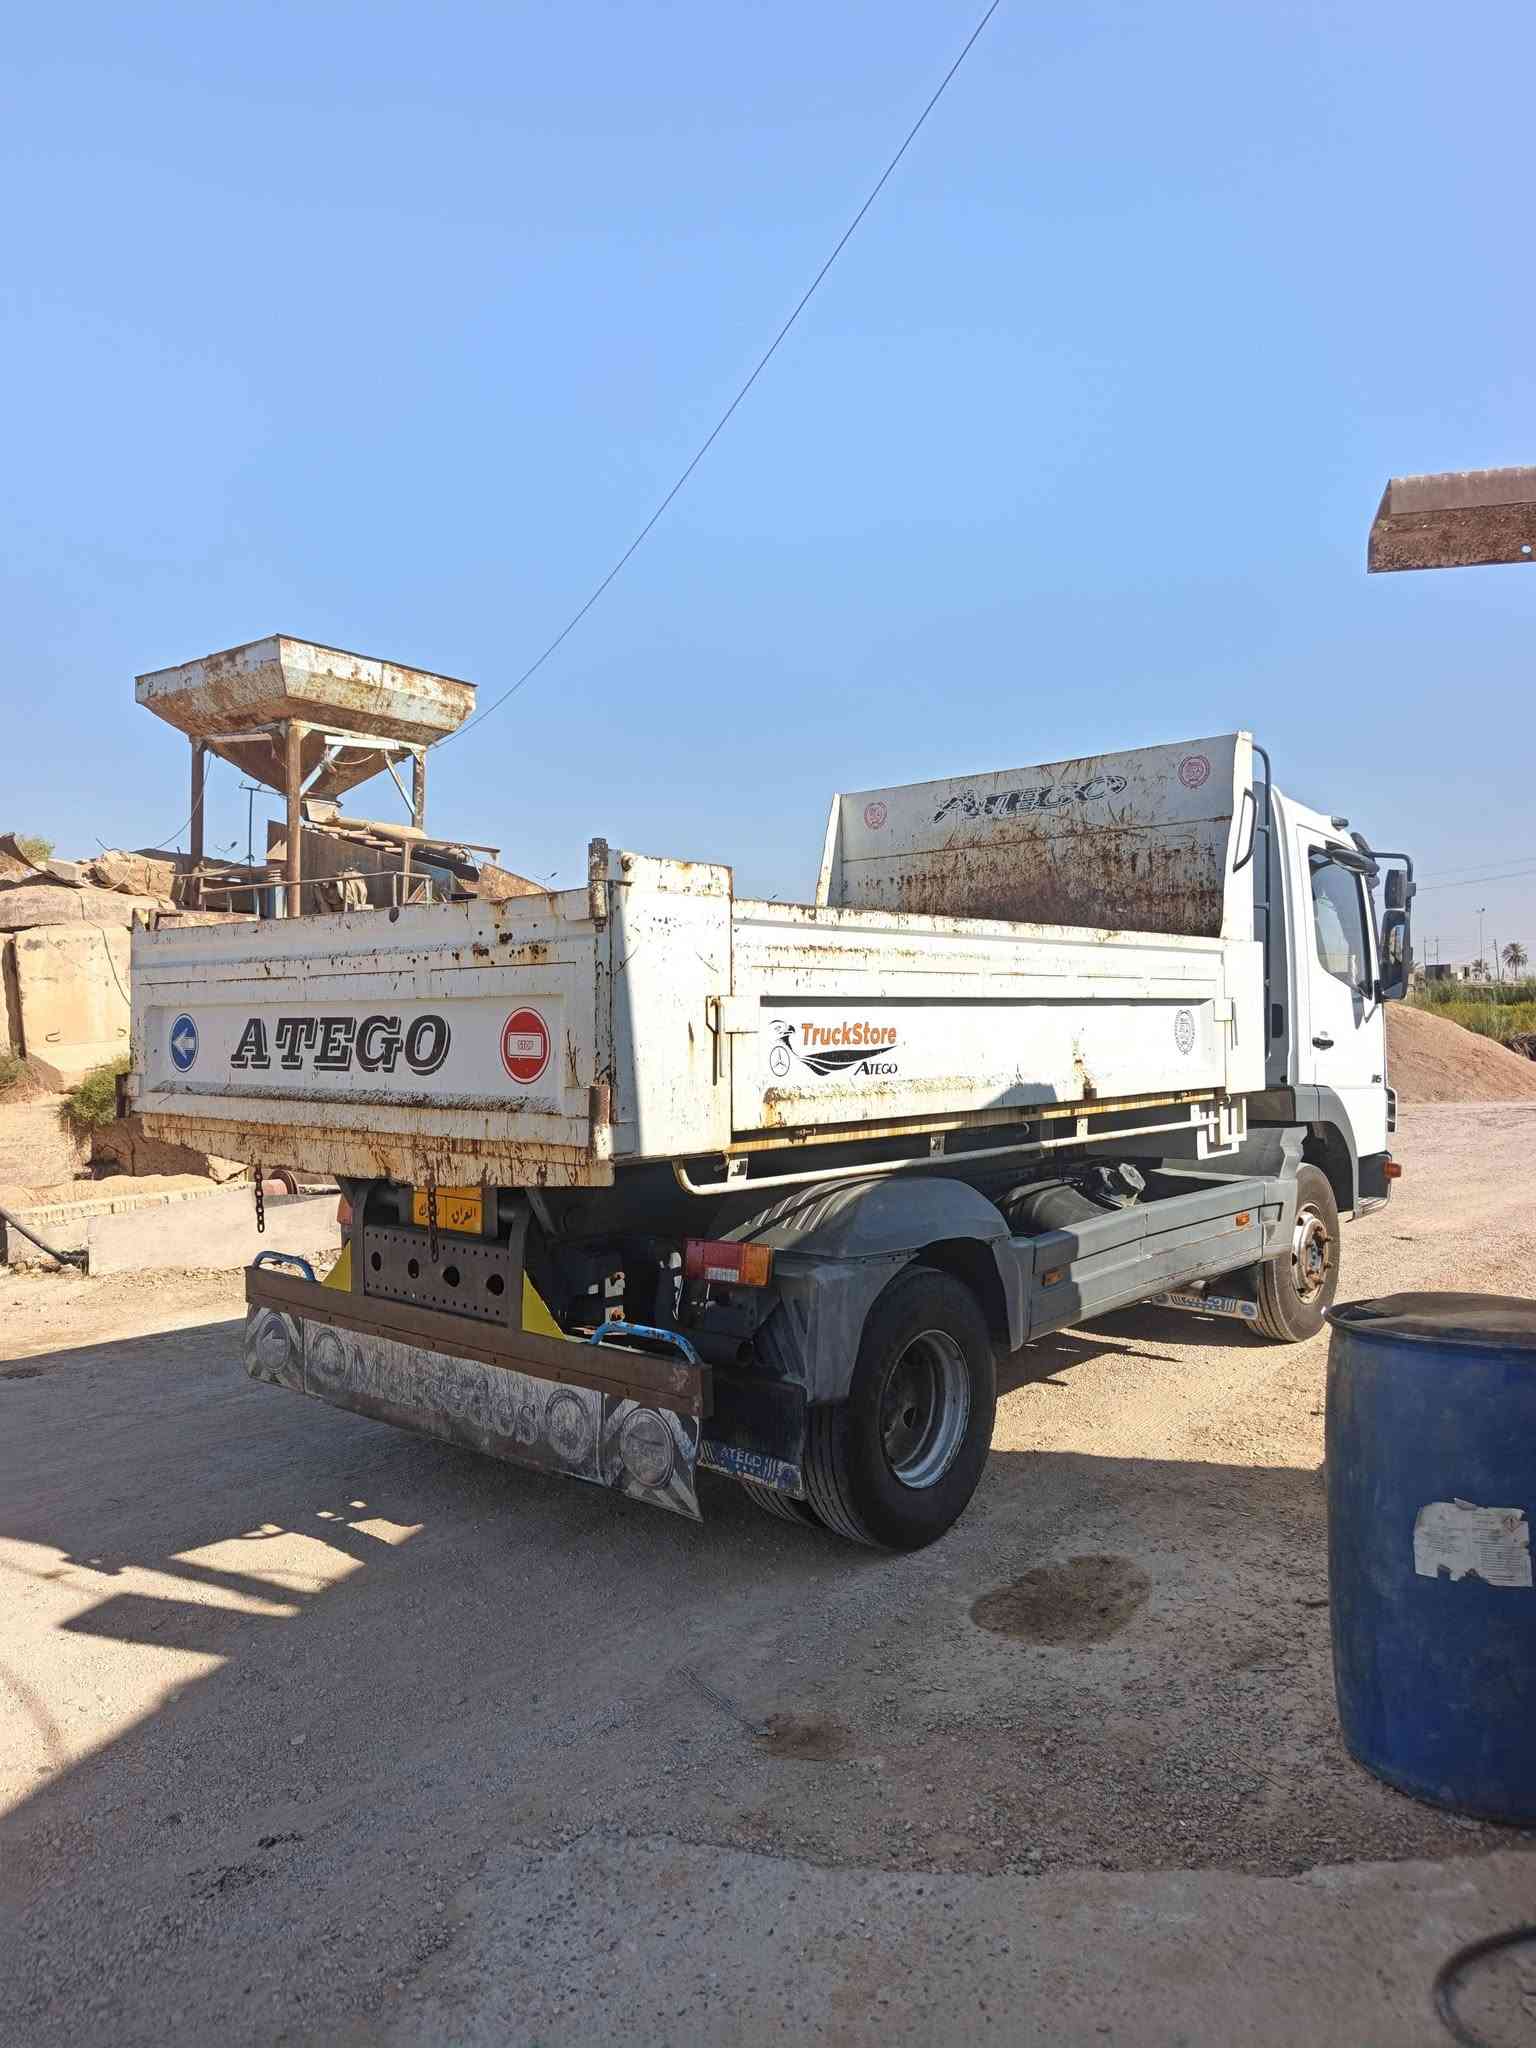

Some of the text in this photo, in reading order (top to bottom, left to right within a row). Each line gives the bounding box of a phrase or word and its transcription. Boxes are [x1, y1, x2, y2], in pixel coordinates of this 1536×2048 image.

[230, 1014, 451, 1076] ATEGO
[801, 1021, 897, 1046] TruckStore
[853, 1060, 898, 1076] ATEGO
